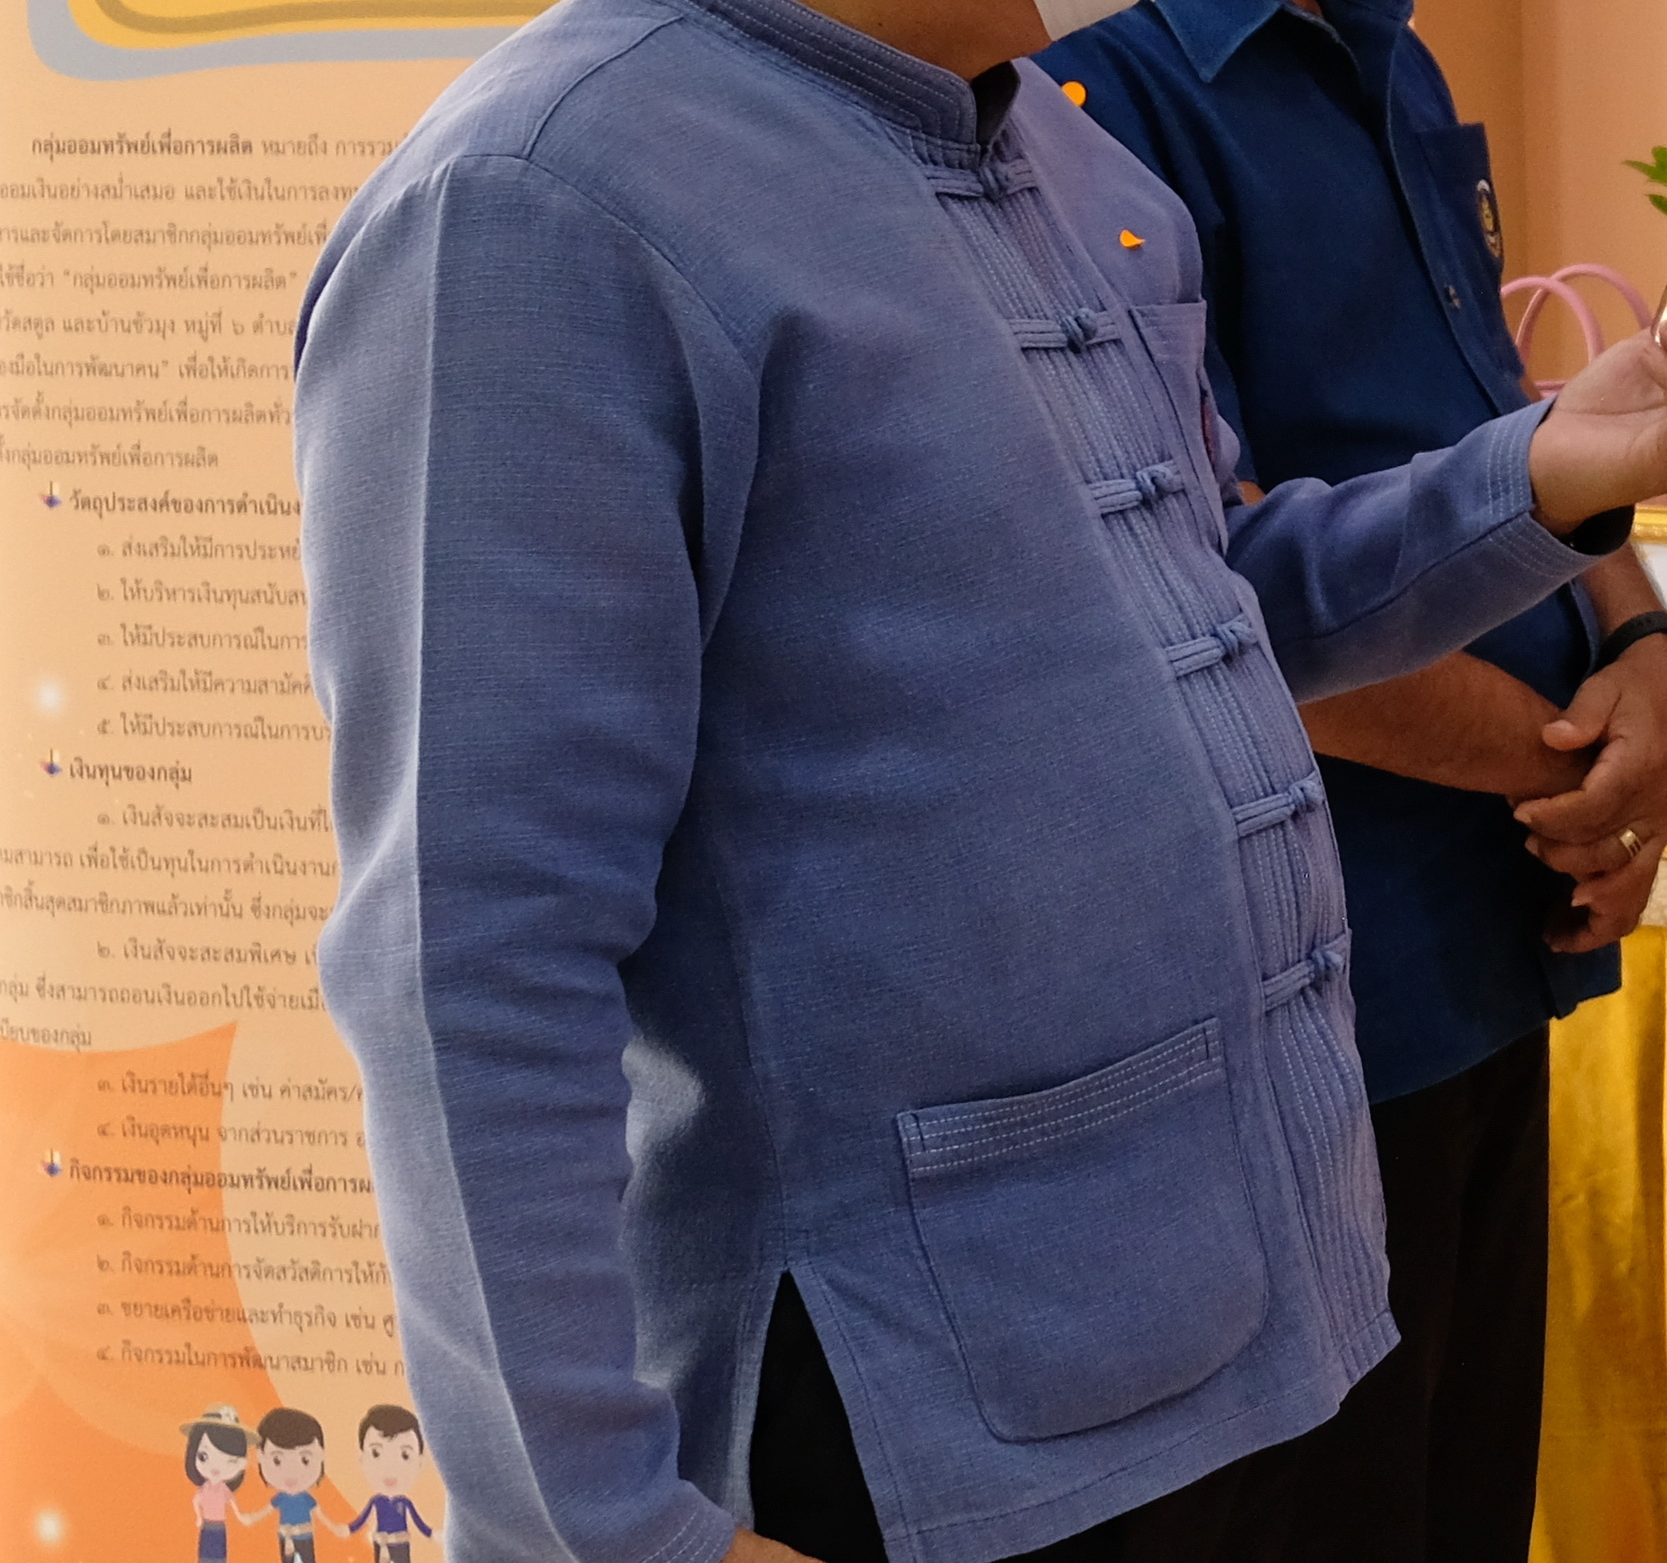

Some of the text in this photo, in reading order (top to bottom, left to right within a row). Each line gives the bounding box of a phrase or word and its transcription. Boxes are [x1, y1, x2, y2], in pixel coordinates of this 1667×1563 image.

[31, 127, 398, 163] กลุ่มออมทรัพย์เพื่อการผลิต หมายถึง การรวม
[2, 309, 55, 340] วัดสตูล
[178, 350, 289, 381] เพื่อให้เกิดการ
[68, 488, 300, 521] วัตถุประสงค์ของการดำเนินง
[69, 756, 193, 791] เงินทุนของกลุ่ม
[0, 848, 73, 868] มสามารถ
[250, 891, 329, 928] ซึ่งกลุ่มจะ
[242, 1076, 273, 1100] เช่น
[69, 1157, 372, 1195] กิจกรรมของกลุ่มออมทรัพย์เพื่อการผ
[344, 1306, 376, 1330] เช่น
[355, 1351, 387, 1376] เช่น
